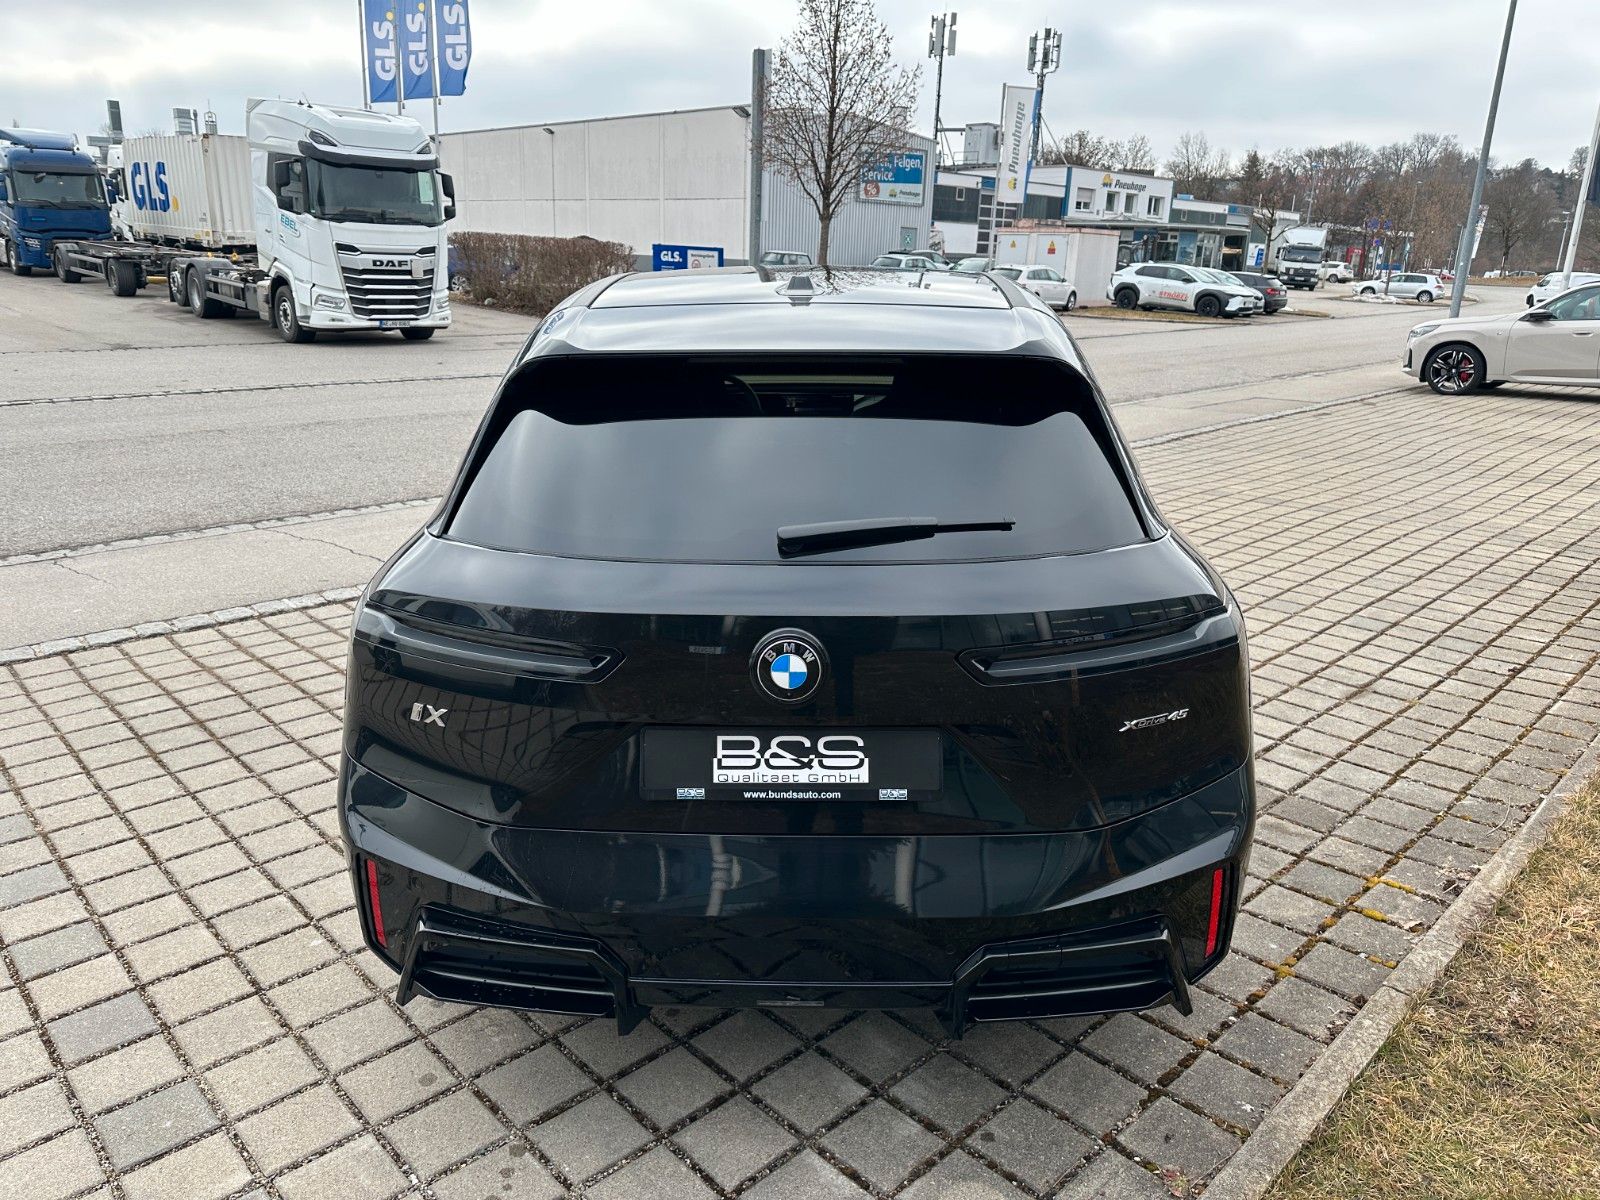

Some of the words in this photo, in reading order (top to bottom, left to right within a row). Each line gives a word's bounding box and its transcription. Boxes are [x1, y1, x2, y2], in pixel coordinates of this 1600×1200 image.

[1009, 102, 1026, 174] Pneuhage
[894, 155, 922, 172] Felgen,
[1115, 179, 1147, 192] Pneuhage
[372, 259, 409, 267] DAF
[764, 642, 816, 663] BMW
[716, 735, 865, 770] B&S
[717, 773, 800, 783] Qualitaet
[743, 789, 841, 799] www.bundsauto.com
